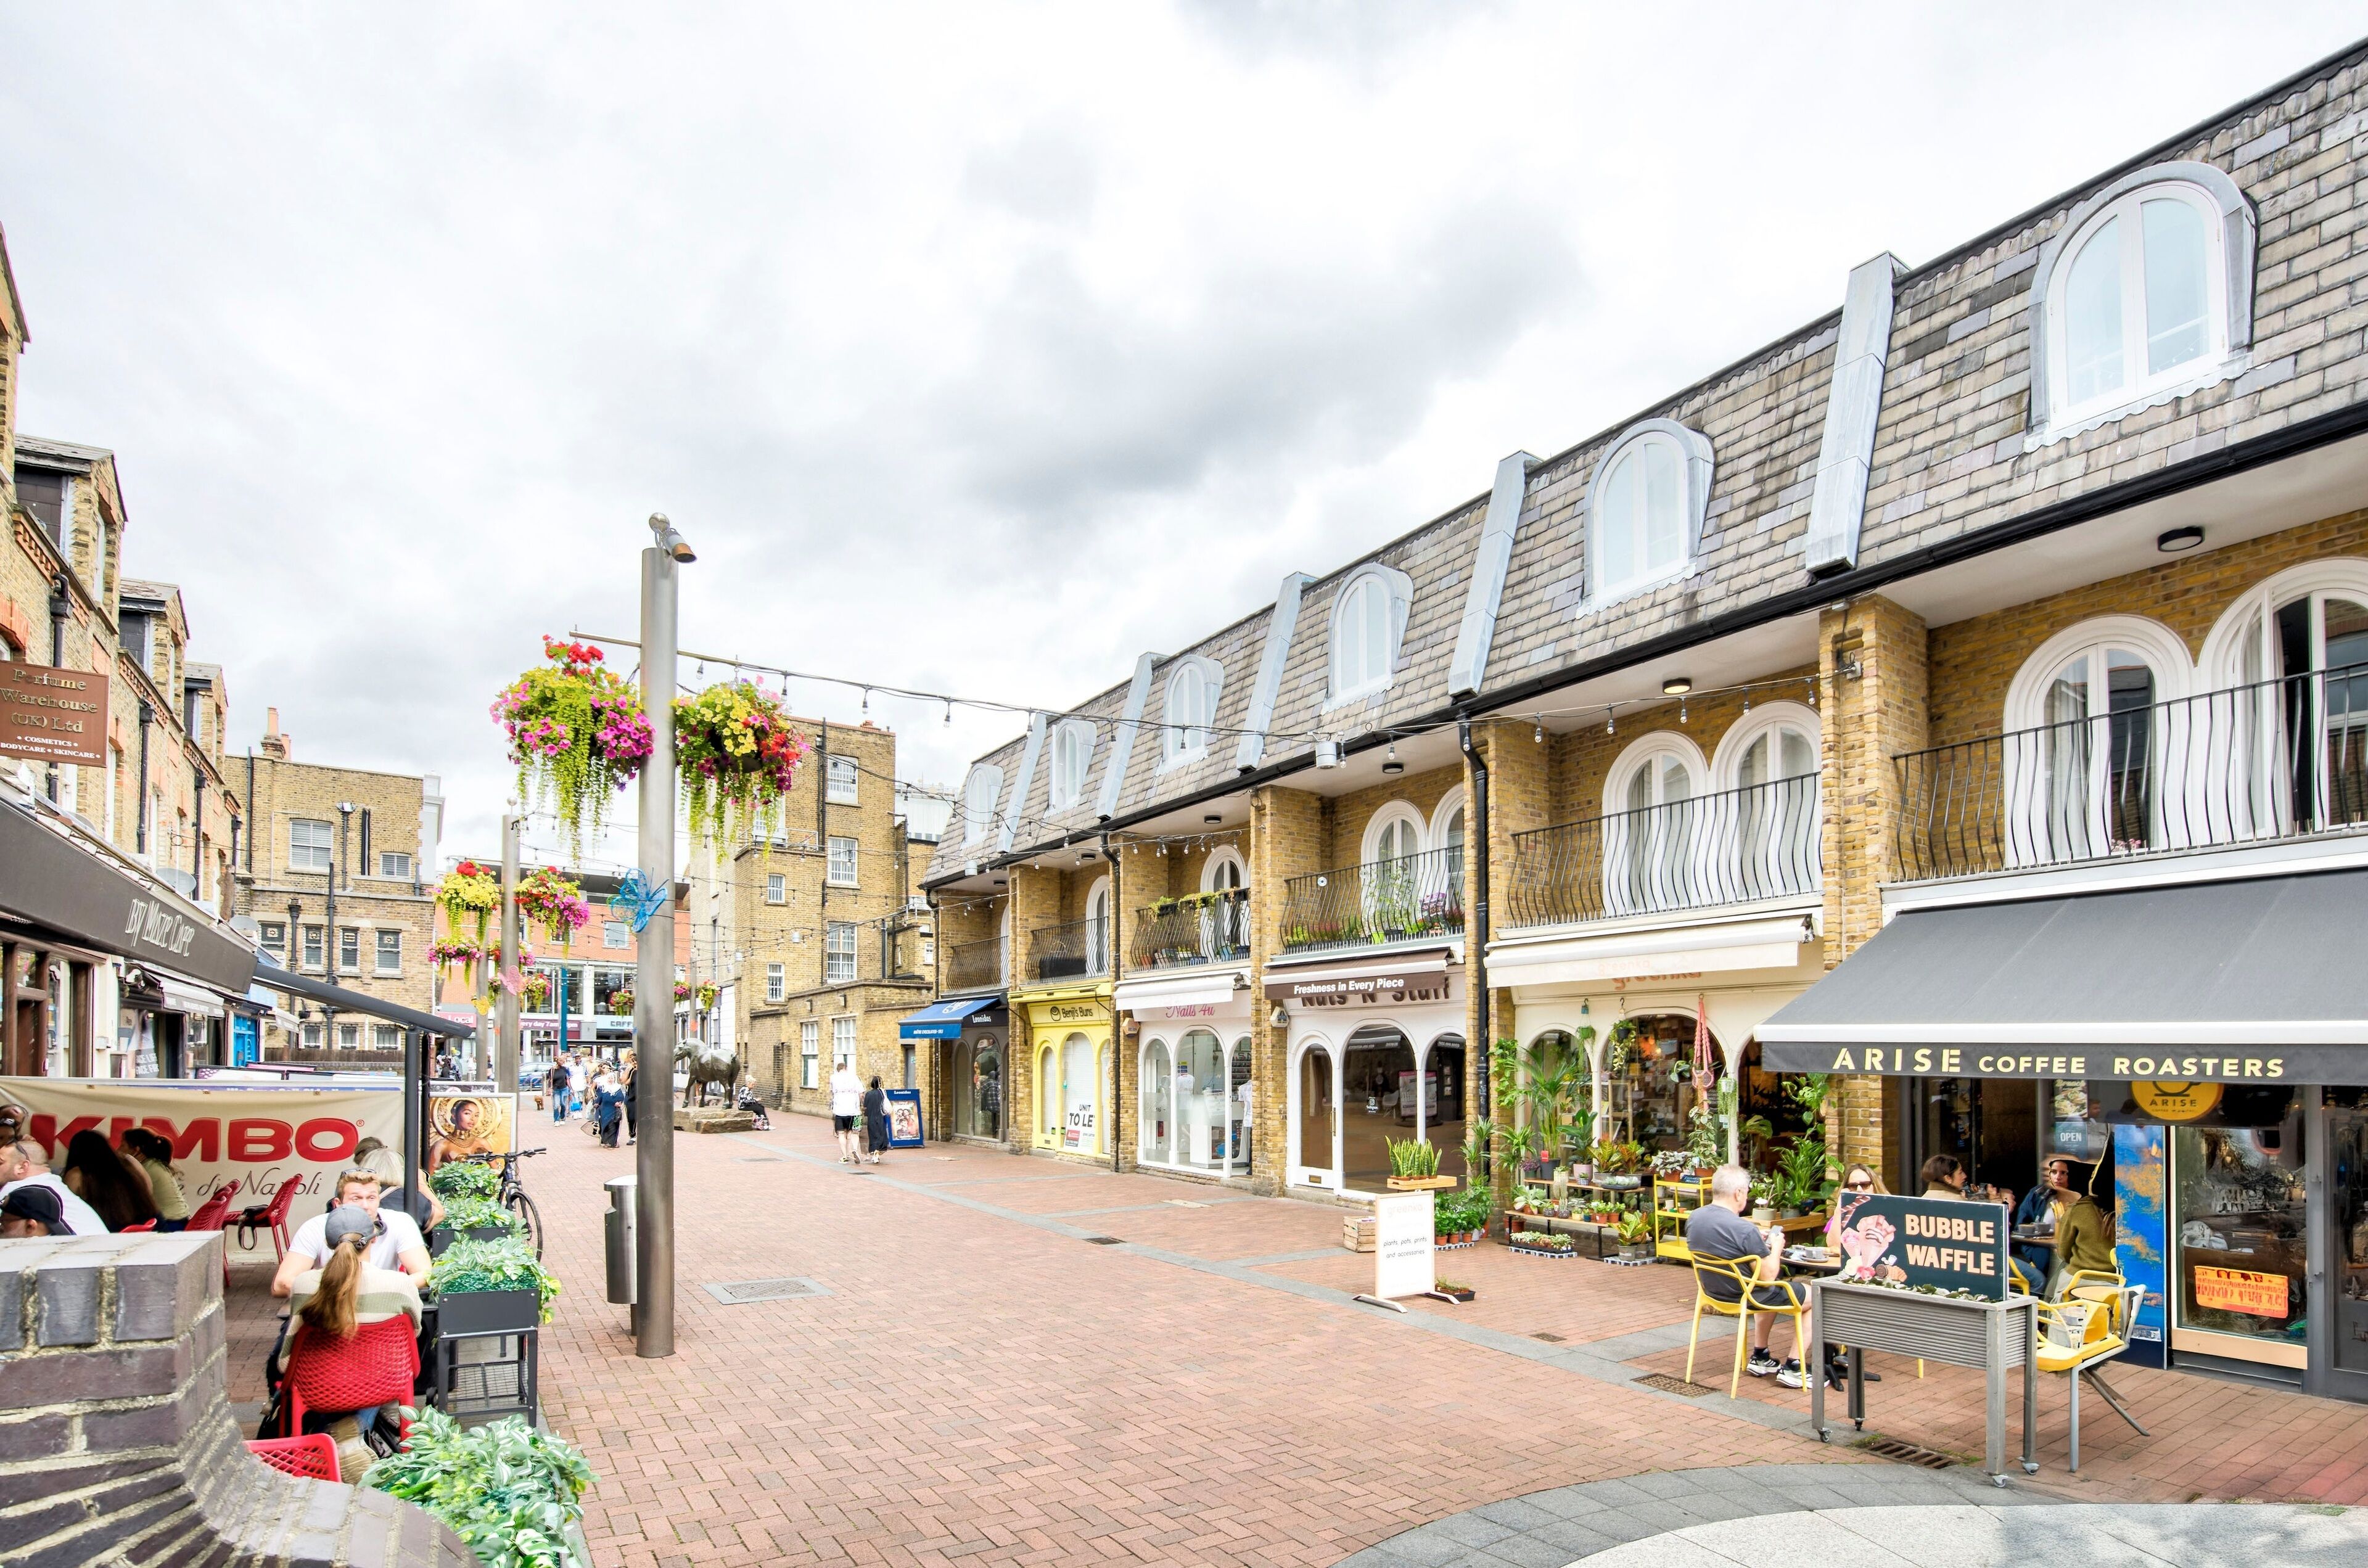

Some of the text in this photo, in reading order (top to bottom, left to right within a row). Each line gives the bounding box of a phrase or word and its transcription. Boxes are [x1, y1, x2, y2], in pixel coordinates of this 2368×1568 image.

[12, 668, 86, 691] Prfume
[0, 688, 98, 712] Warehouse
[11, 712, 84, 733] (UK) Ltd
[25, 736, 72, 747] COSMETICS
[0, 742, 95, 758] BODYCARE SKINCARE
[1294, 977, 1404, 995] Freshness in Every Piece
[972, 1014, 992, 1024] Leonidas
[1079, 1007, 1093, 1017] Buns
[1832, 1048, 2284, 1078] ARISE COFFEE ROASTERS
[2149, 1099, 2197, 1107] ARISE
[1069, 1112, 1095, 1128] TO LE
[2060, 1132, 2082, 1142] OPEN
[236, 1167, 323, 1196] Naoli
[1905, 1213, 1995, 1244] BUBBLE
[1414, 1236, 1428, 1244] prints
[1397, 1249, 1425, 1257] accessories
[1906, 1244, 1995, 1276] WAFFLE
